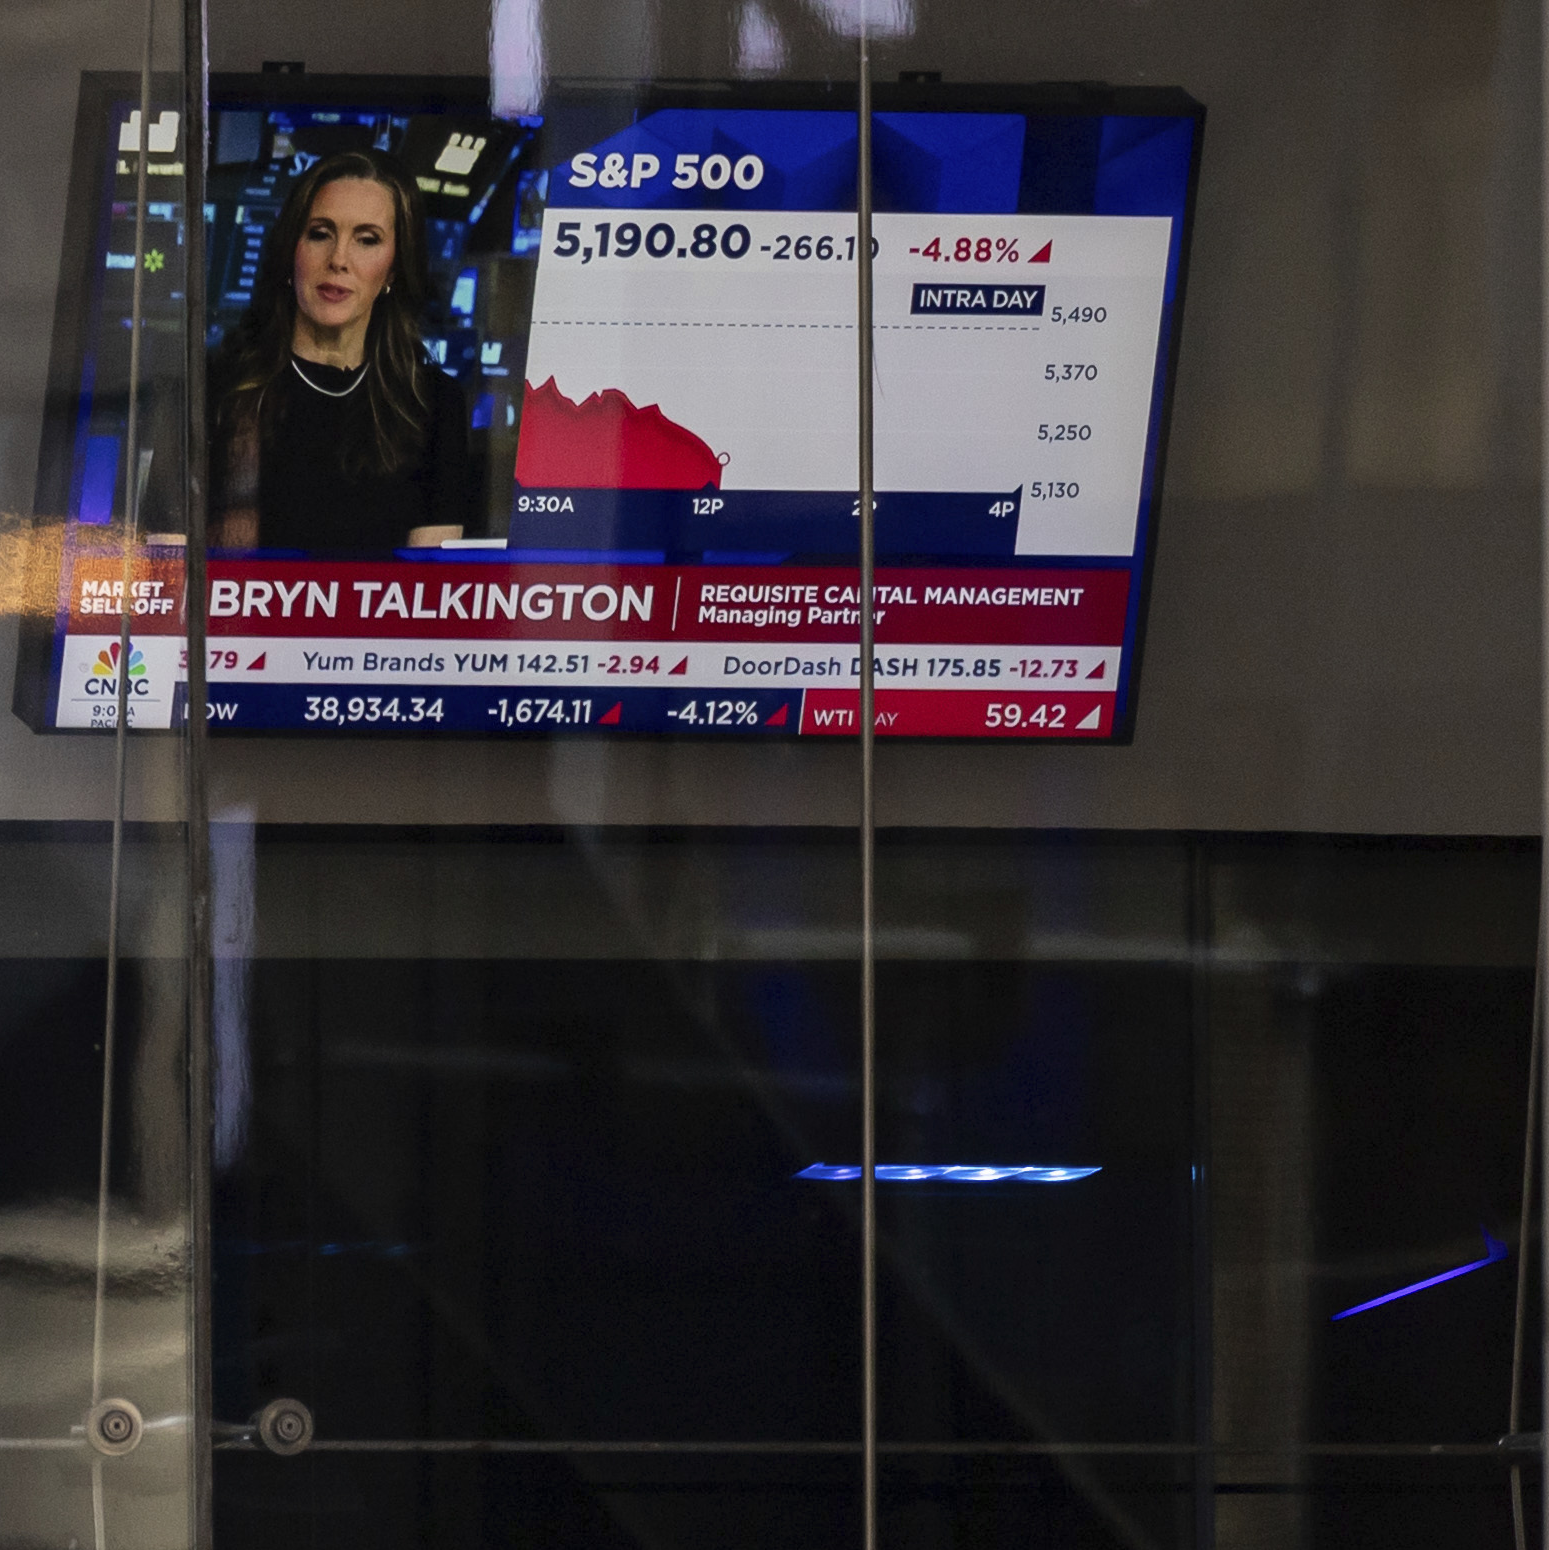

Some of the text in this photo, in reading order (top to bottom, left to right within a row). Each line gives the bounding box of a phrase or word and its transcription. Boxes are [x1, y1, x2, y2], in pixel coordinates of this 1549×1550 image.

[568, 153, 764, 190] S&P 500
[552, 222, 752, 265] 5,190.80
[908, 237, 1020, 263] -4.88%
[918, 289, 1039, 309] INTRA DAY
[1050, 305, 1108, 327] 5,490
[1043, 363, 1099, 385] 5,370
[1036, 423, 1093, 445] 5,250
[1029, 481, 1081, 502] 5,130
[517, 495, 574, 513] 9:30A
[691, 497, 724, 515] 12P
[987, 500, 1015, 518] 4P
[209, 580, 655, 623] BRYN TALKINGTON
[701, 584, 819, 604] REQUISITE
[923, 586, 1085, 607] MANAGEMENT
[698, 604, 886, 628] Managing Partnr
[303, 650, 354, 673] Yum
[364, 652, 445, 673] Brands
[454, 653, 510, 673] YUM
[516, 653, 590, 673] 142.51
[597, 655, 661, 674] -2.94
[723, 656, 842, 677] DoorDash
[927, 657, 1002, 678] 175.85
[1009, 659, 1079, 679] -12.73
[303, 696, 759, 727] 38,934.34 -1,674.11 -4.12%
[812, 708, 855, 727] WTI
[984, 703, 1067, 729] 59.42
